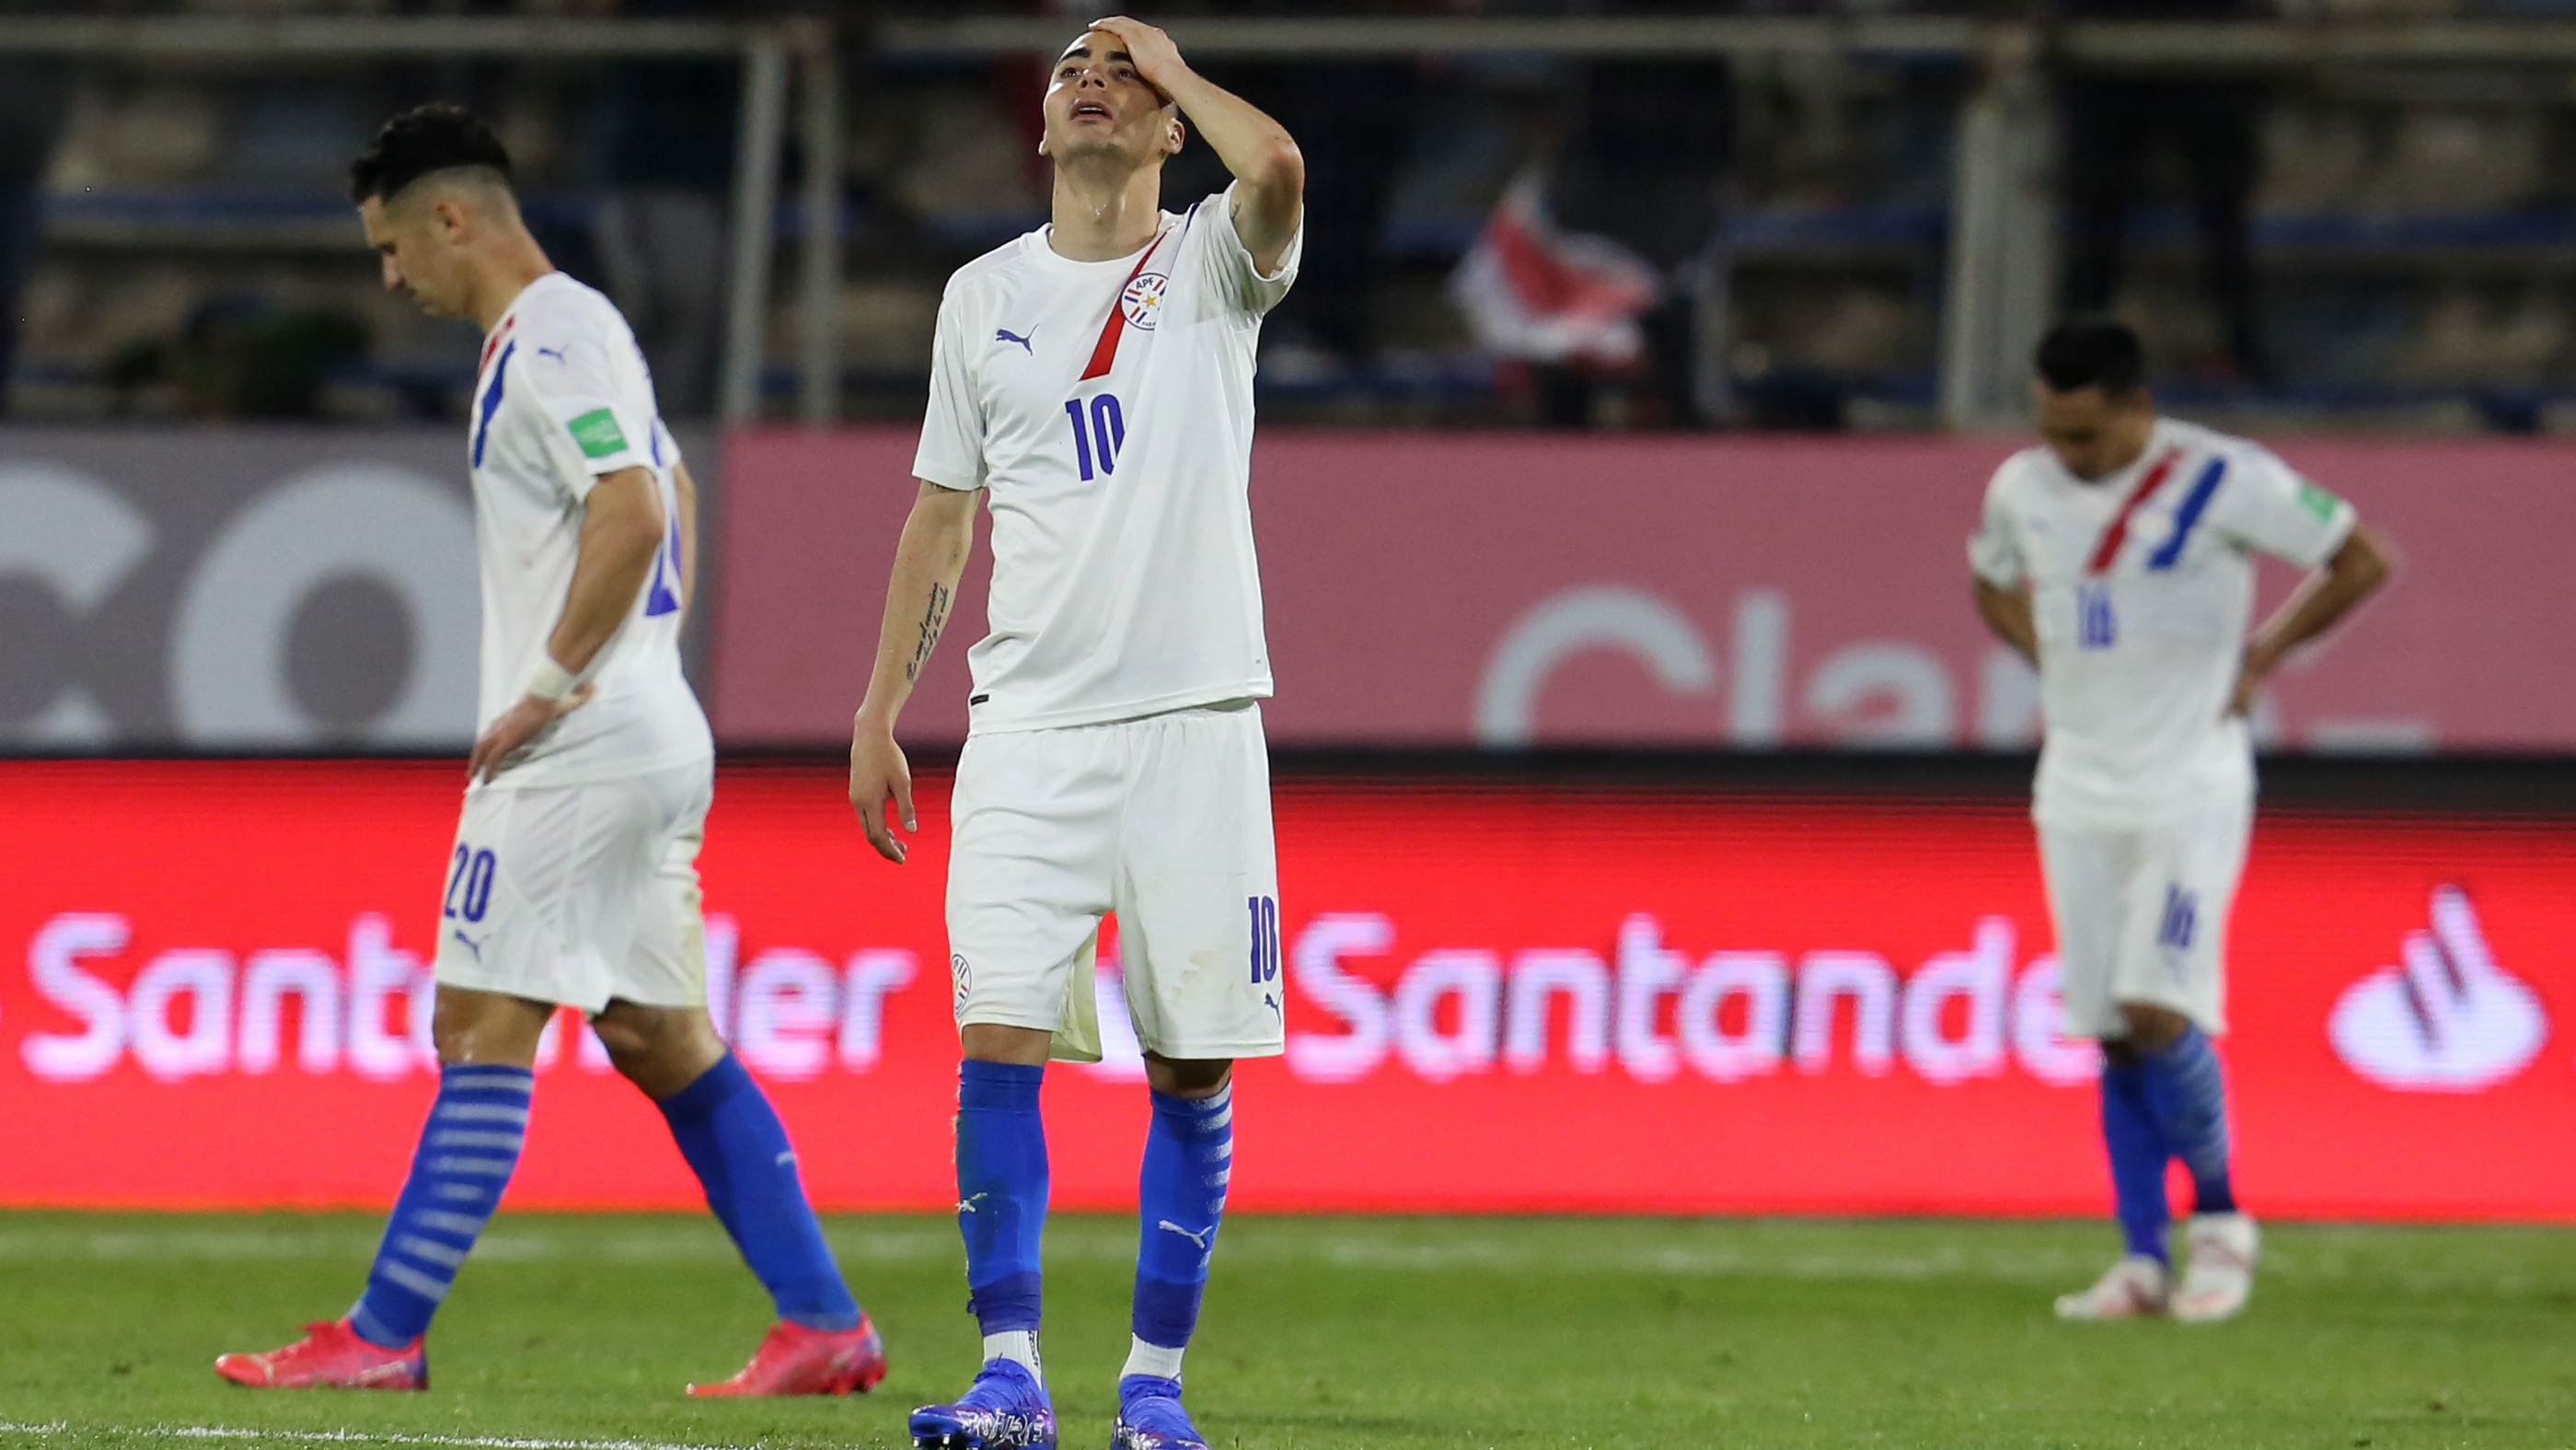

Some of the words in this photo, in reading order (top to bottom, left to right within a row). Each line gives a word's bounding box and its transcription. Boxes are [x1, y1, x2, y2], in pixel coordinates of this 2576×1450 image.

[1136, 277, 1154, 290] APF
[1065, 393, 1126, 481] 10
[1476, 585, 2279, 749] Cla
[444, 841, 496, 922] 20
[1248, 895, 1277, 984] 10
[20, 911, 917, 1083] Santer
[1285, 911, 2106, 1085] Santande
